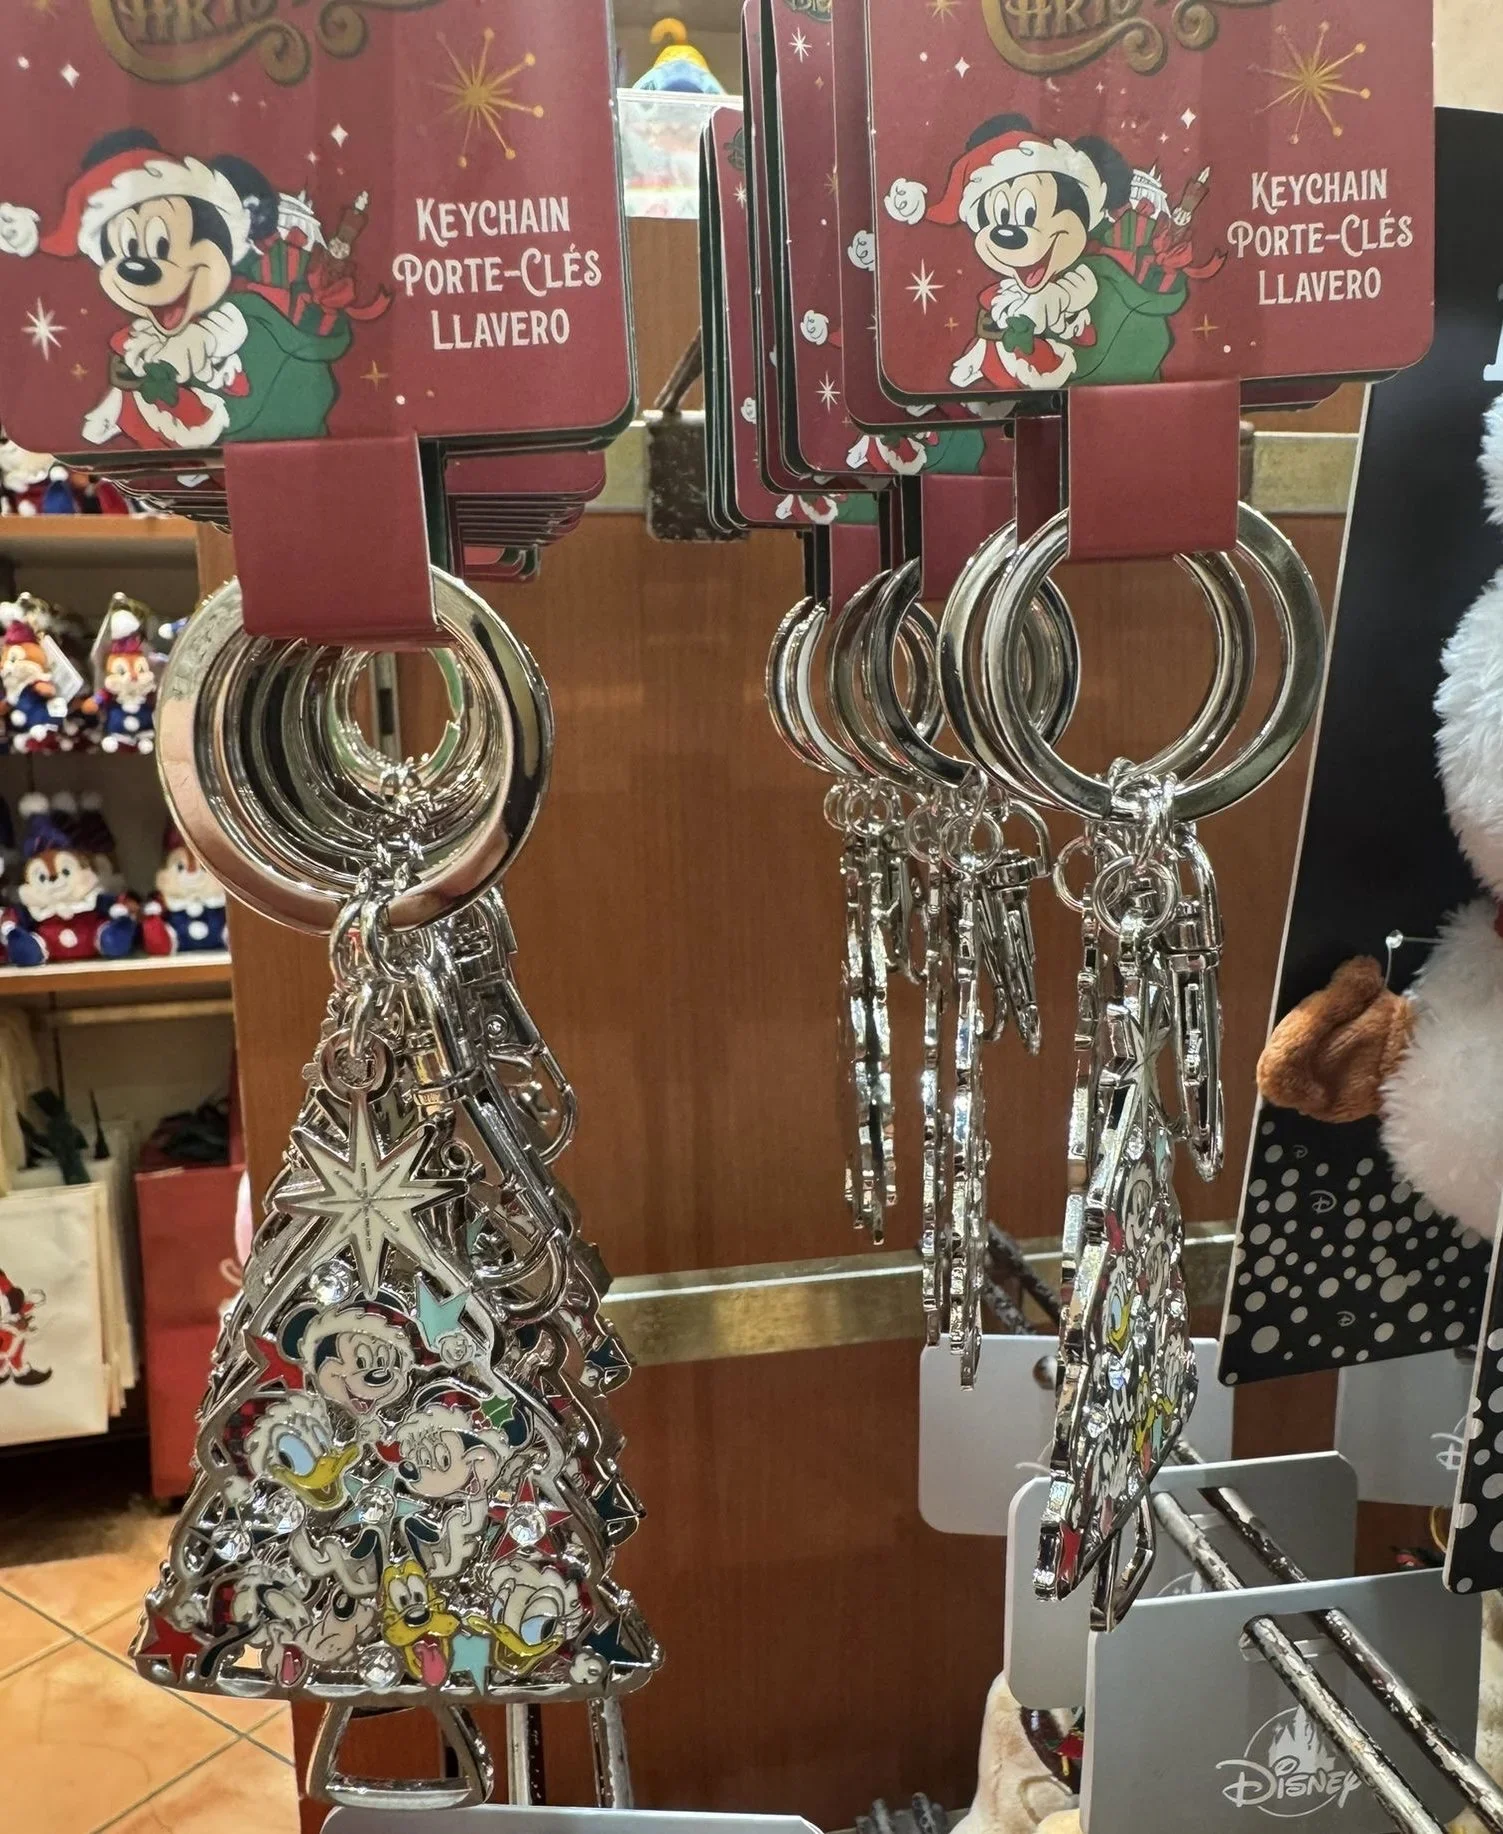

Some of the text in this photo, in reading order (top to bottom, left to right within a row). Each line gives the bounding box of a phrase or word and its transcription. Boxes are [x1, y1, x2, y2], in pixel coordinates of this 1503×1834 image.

[1251, 168, 1388, 215] KEYCHAIN
[416, 197, 571, 247] KEYCHAIN
[1227, 208, 1414, 258] PORTE-CLÉS
[392, 243, 602, 297] PORTE-CLÉS
[1258, 267, 1382, 305] LLAVERO
[431, 308, 570, 350] LLAVERO
